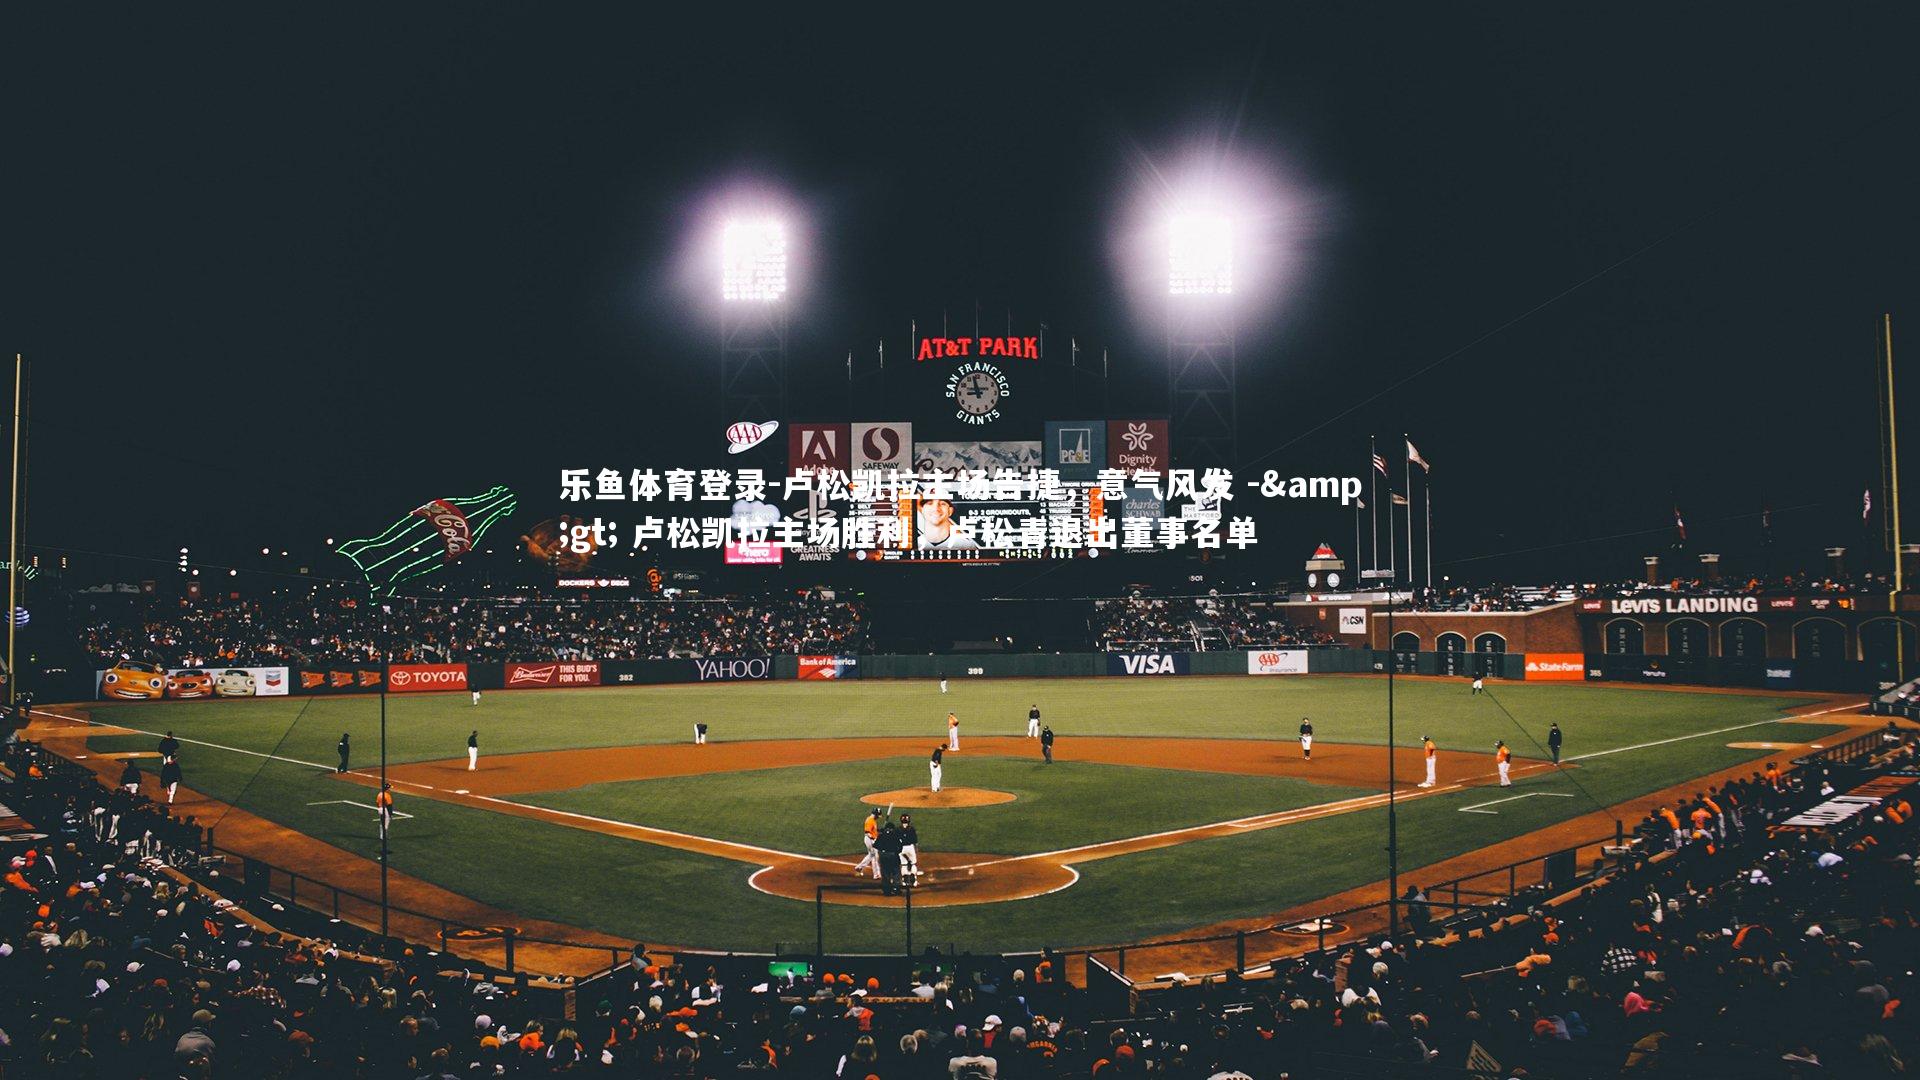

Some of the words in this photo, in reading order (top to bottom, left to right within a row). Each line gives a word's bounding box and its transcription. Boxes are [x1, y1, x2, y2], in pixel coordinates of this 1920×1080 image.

[918, 337, 972, 361] AT&T
[978, 337, 1038, 360] PARK
[946, 374, 964, 398] SAN
[958, 361, 1010, 397] FRANCISCO
[956, 409, 1006, 426] GIANTS
[1061, 449, 1090, 463] PG&E
[1119, 454, 1157, 467] Dignity
[862, 462, 900, 470] SAFEWAY
[1125, 499, 1161, 510] charles
[799, 553, 832, 562] AWAITS
[558, 579, 596, 587] DOCKERS
[1665, 597, 1759, 614] LANDING
[1349, 616, 1364, 625] CSN
[799, 658, 818, 667] Bank
[818, 658, 826, 667] of
[826, 658, 857, 667] America
[1118, 654, 1176, 674] VISA
[559, 665, 575, 674] THIS
[576, 664, 598, 674] BUD'S
[695, 658, 771, 680] YAHOO!
[413, 671, 467, 683] TOYOTA
[559, 674, 573, 682] FOR
[575, 673, 590, 682] YOU.
